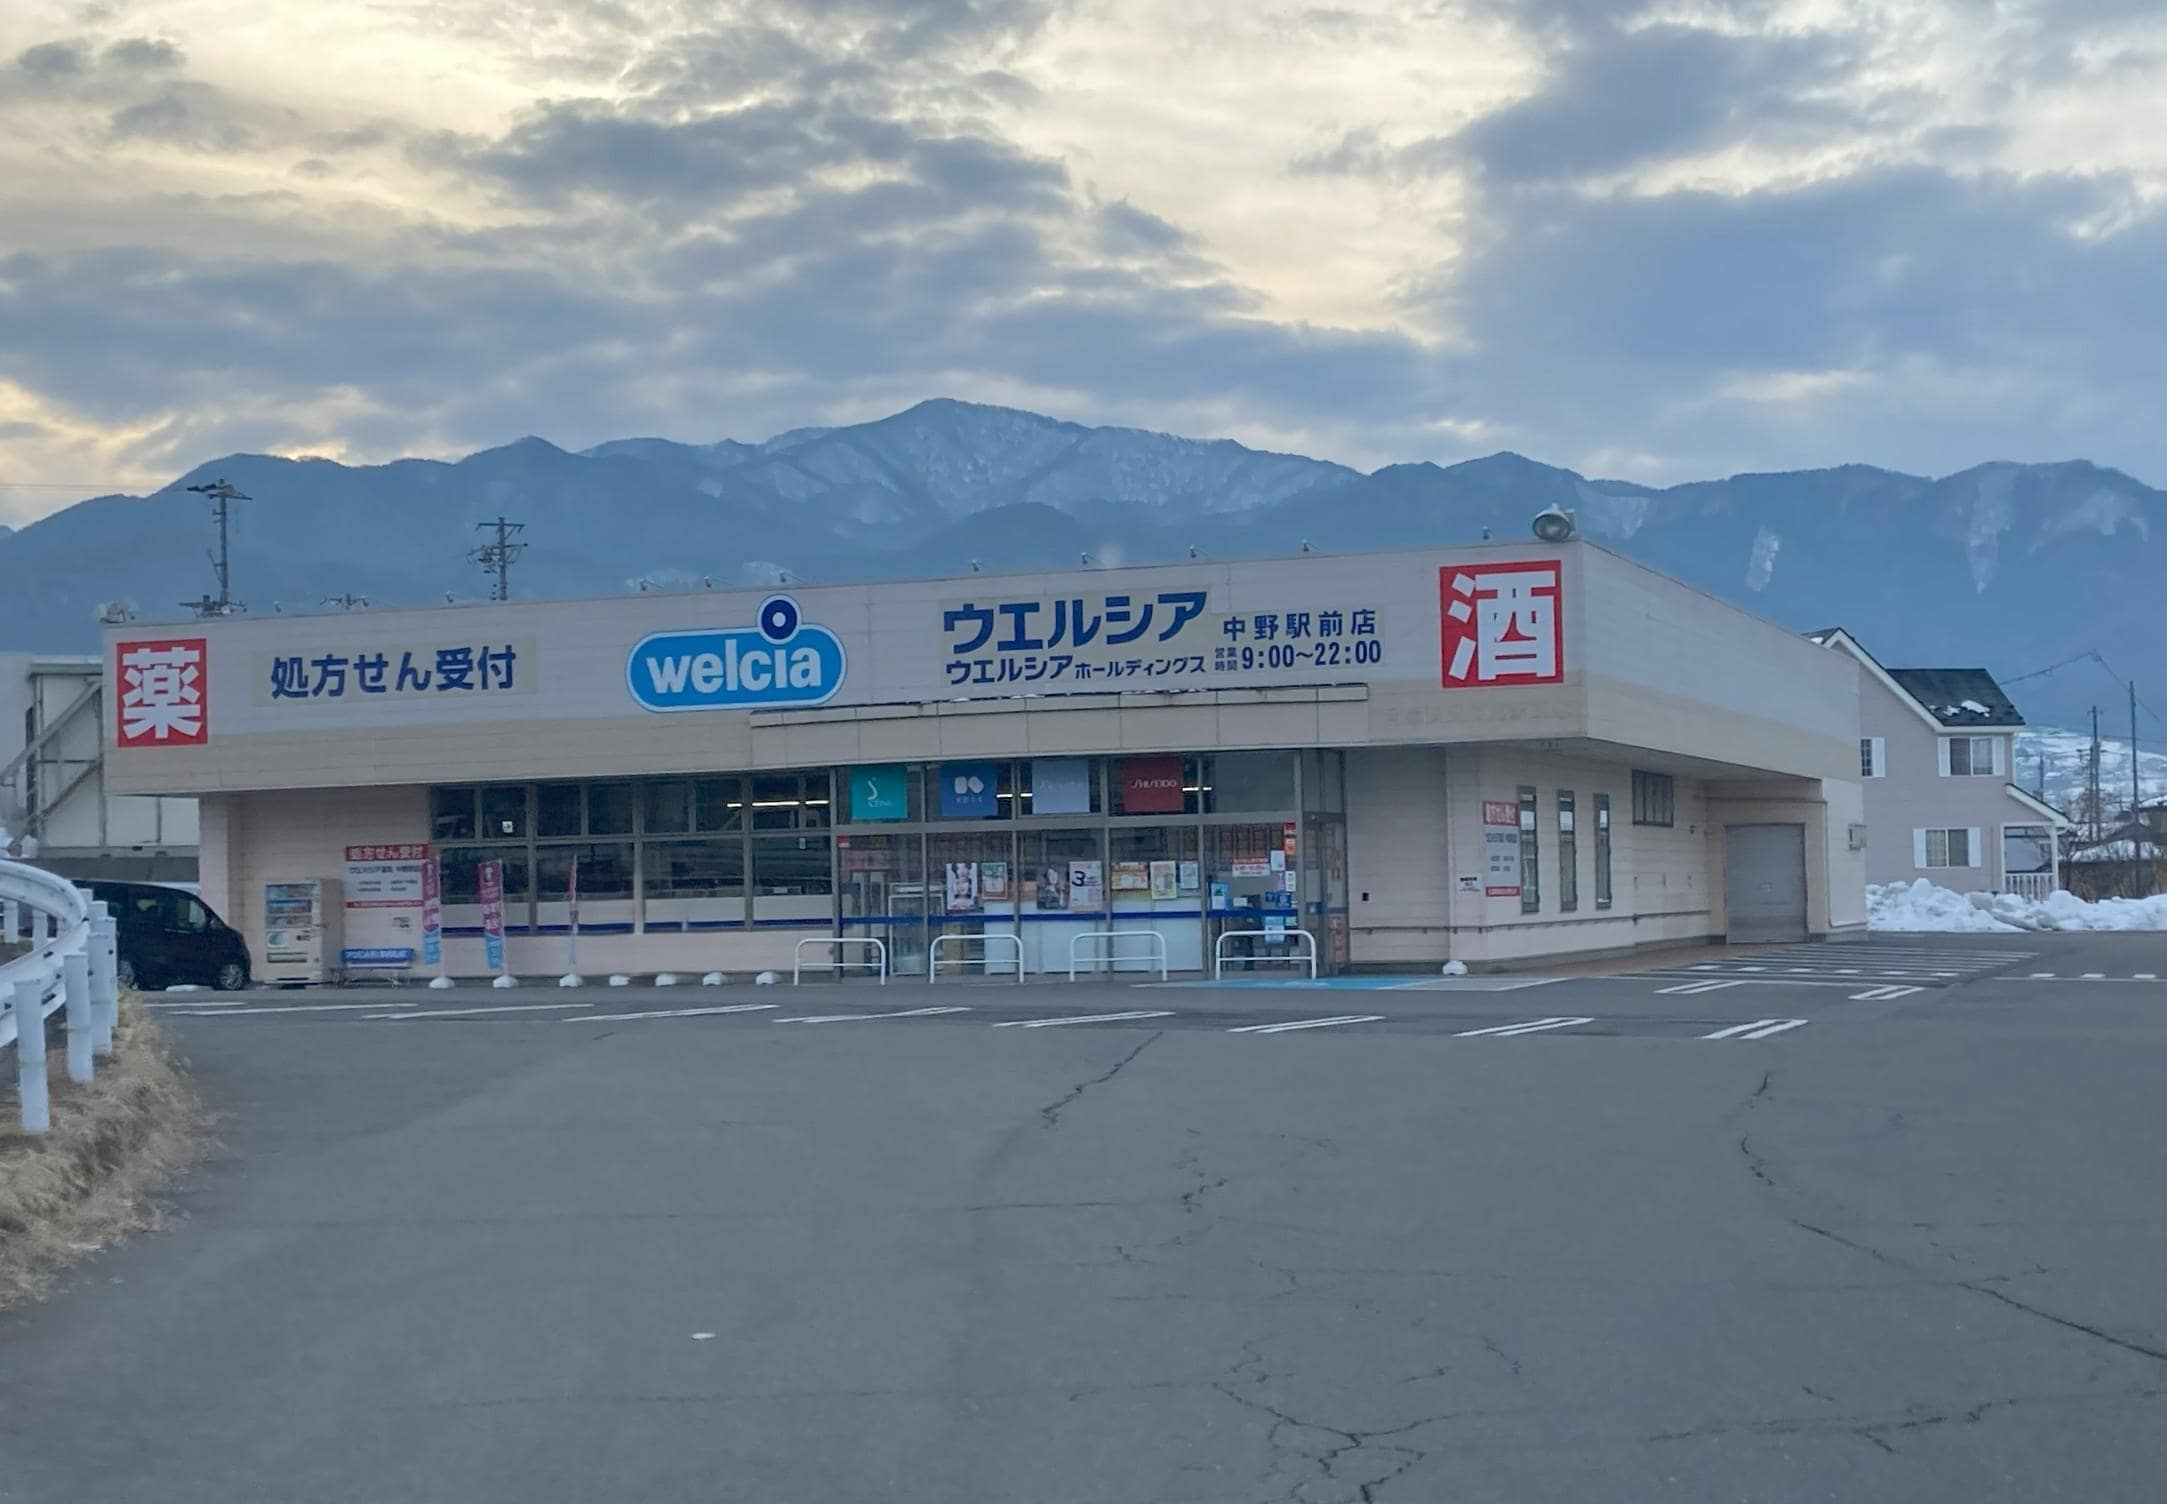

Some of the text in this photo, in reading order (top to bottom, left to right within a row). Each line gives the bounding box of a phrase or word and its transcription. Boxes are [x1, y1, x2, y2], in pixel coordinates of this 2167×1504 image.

[944, 592, 1207, 654] ウエルシア
[1223, 609, 1376, 642] 中野駅前店
[1448, 570, 1556, 681] 酒
[122, 646, 201, 739] 薬
[270, 645, 516, 699] 処方せん受付
[646, 639, 822, 694] welcia
[946, 655, 1206, 685] ウエルシアホールディングス
[1072, 870, 1086, 887] 3
